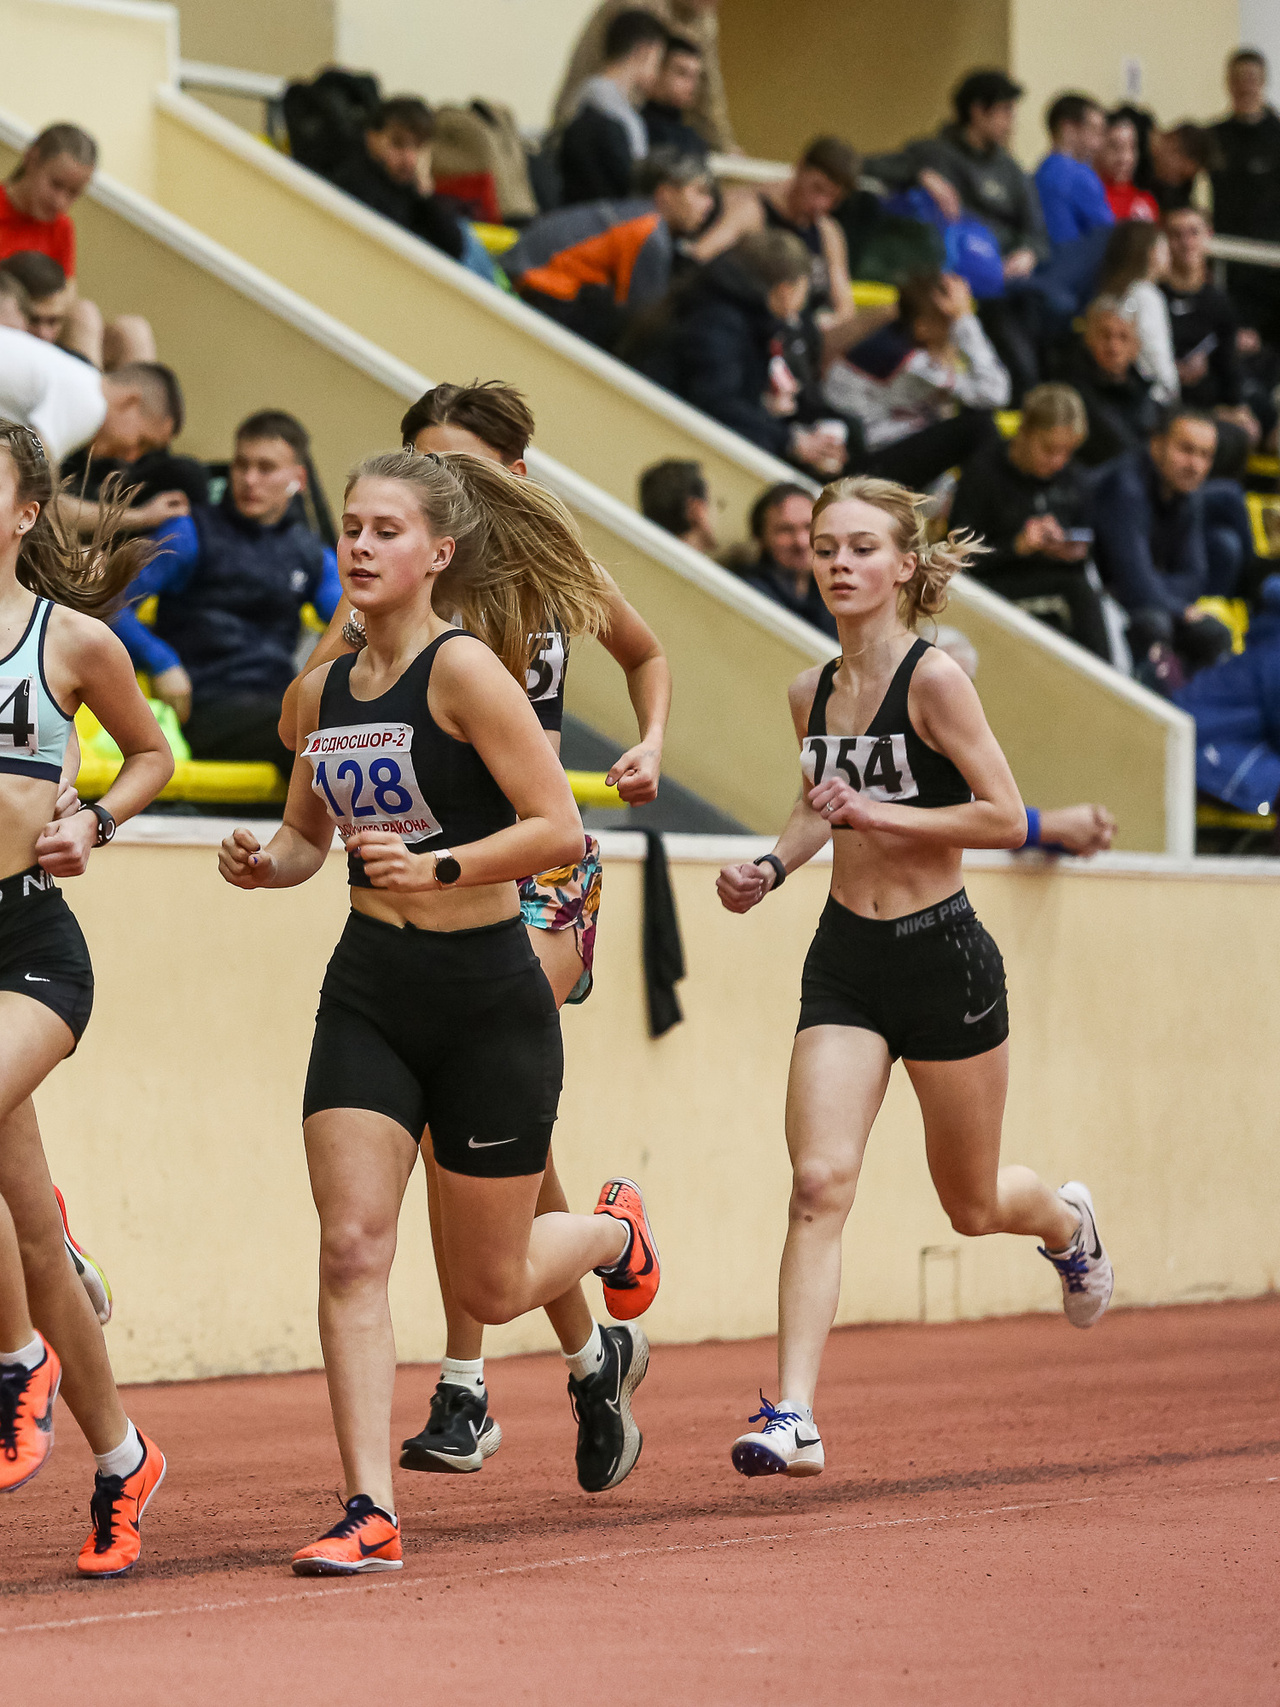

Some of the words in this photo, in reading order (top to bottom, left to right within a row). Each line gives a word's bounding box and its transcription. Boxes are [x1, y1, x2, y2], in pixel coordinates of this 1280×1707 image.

[320, 733, 406, 753] СДЮСШОР-2
[808, 738, 903, 793] 254
[316, 757, 413, 817] 128
[382, 818, 431, 836] РАЙОНА
[896, 911, 936, 937] NIKE
[939, 895, 967, 921] PRO
